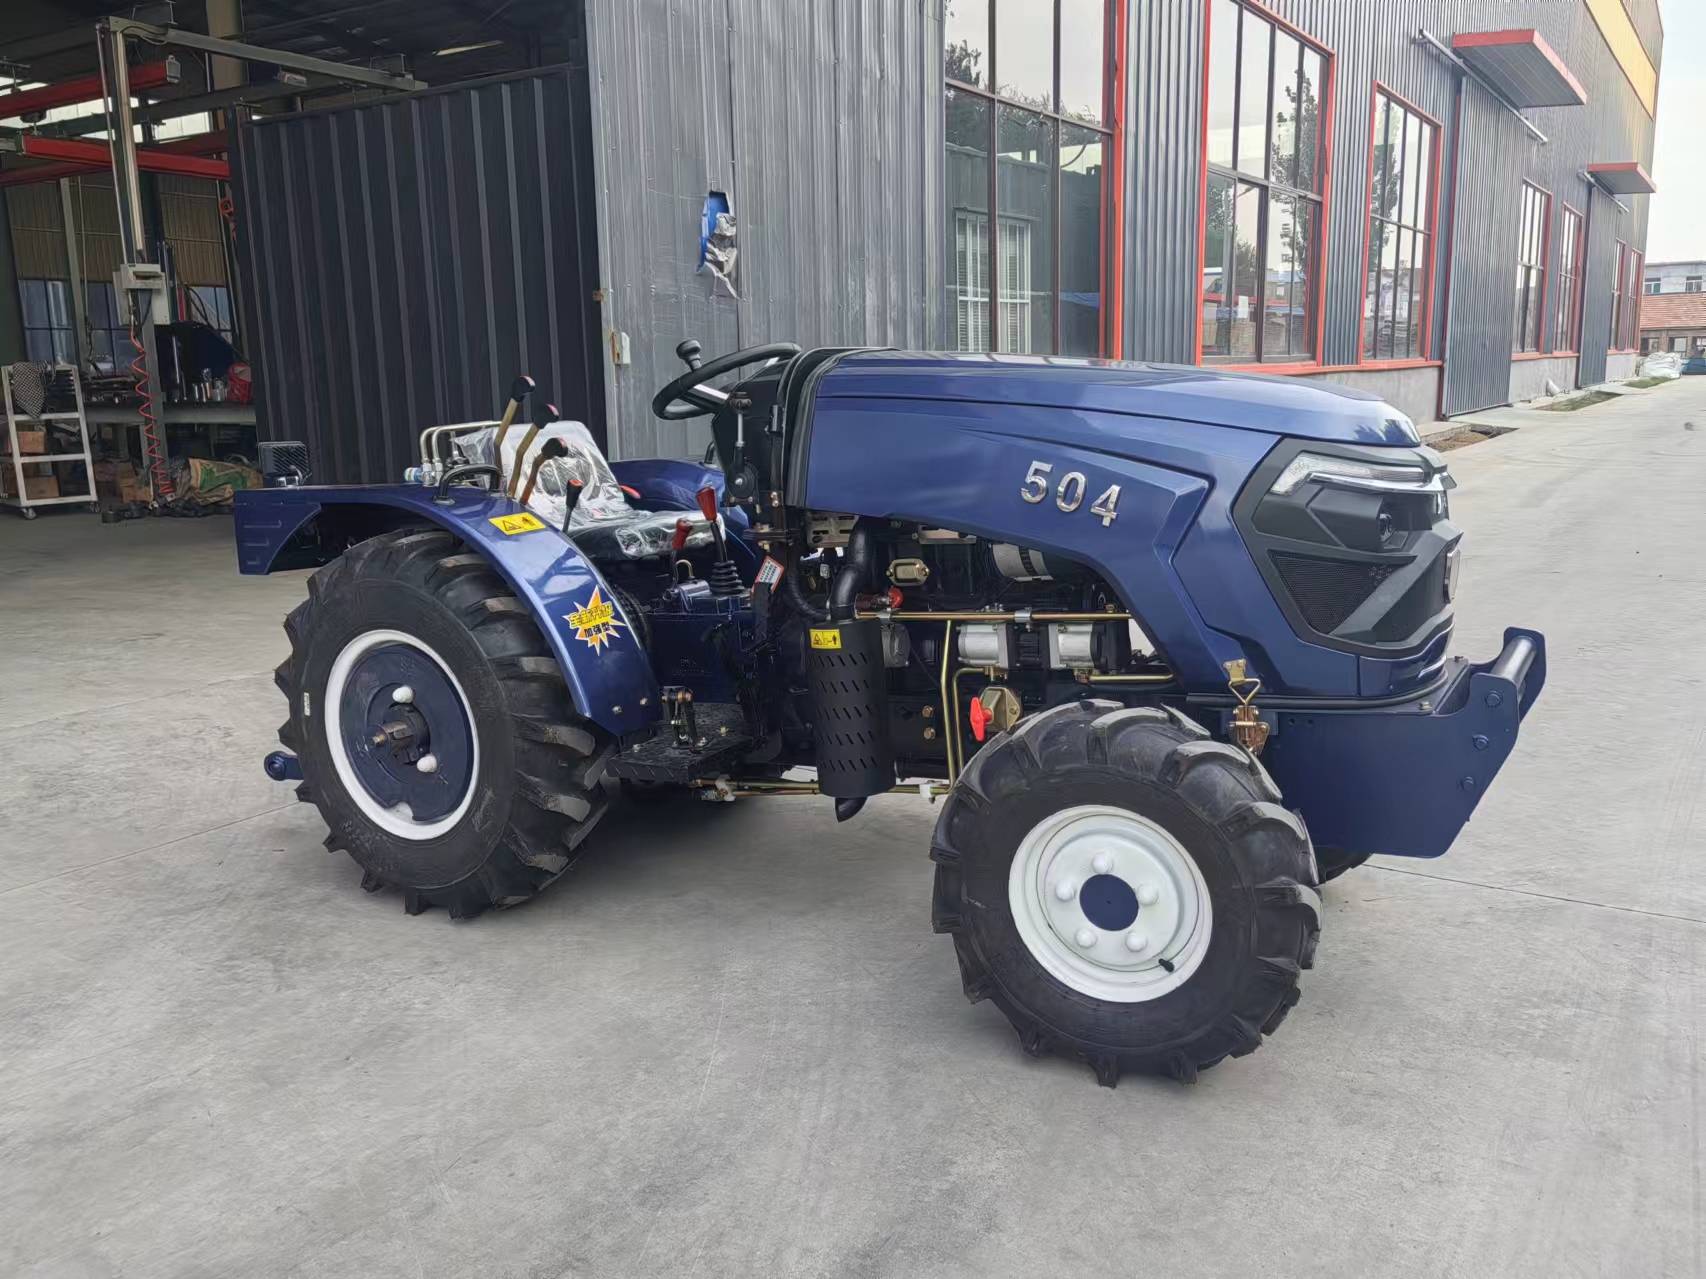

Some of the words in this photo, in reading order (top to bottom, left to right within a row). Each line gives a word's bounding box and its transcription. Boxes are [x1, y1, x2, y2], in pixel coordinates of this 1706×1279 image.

[1020, 460, 1121, 527] 504
[584, 621, 611, 638] 加强型
